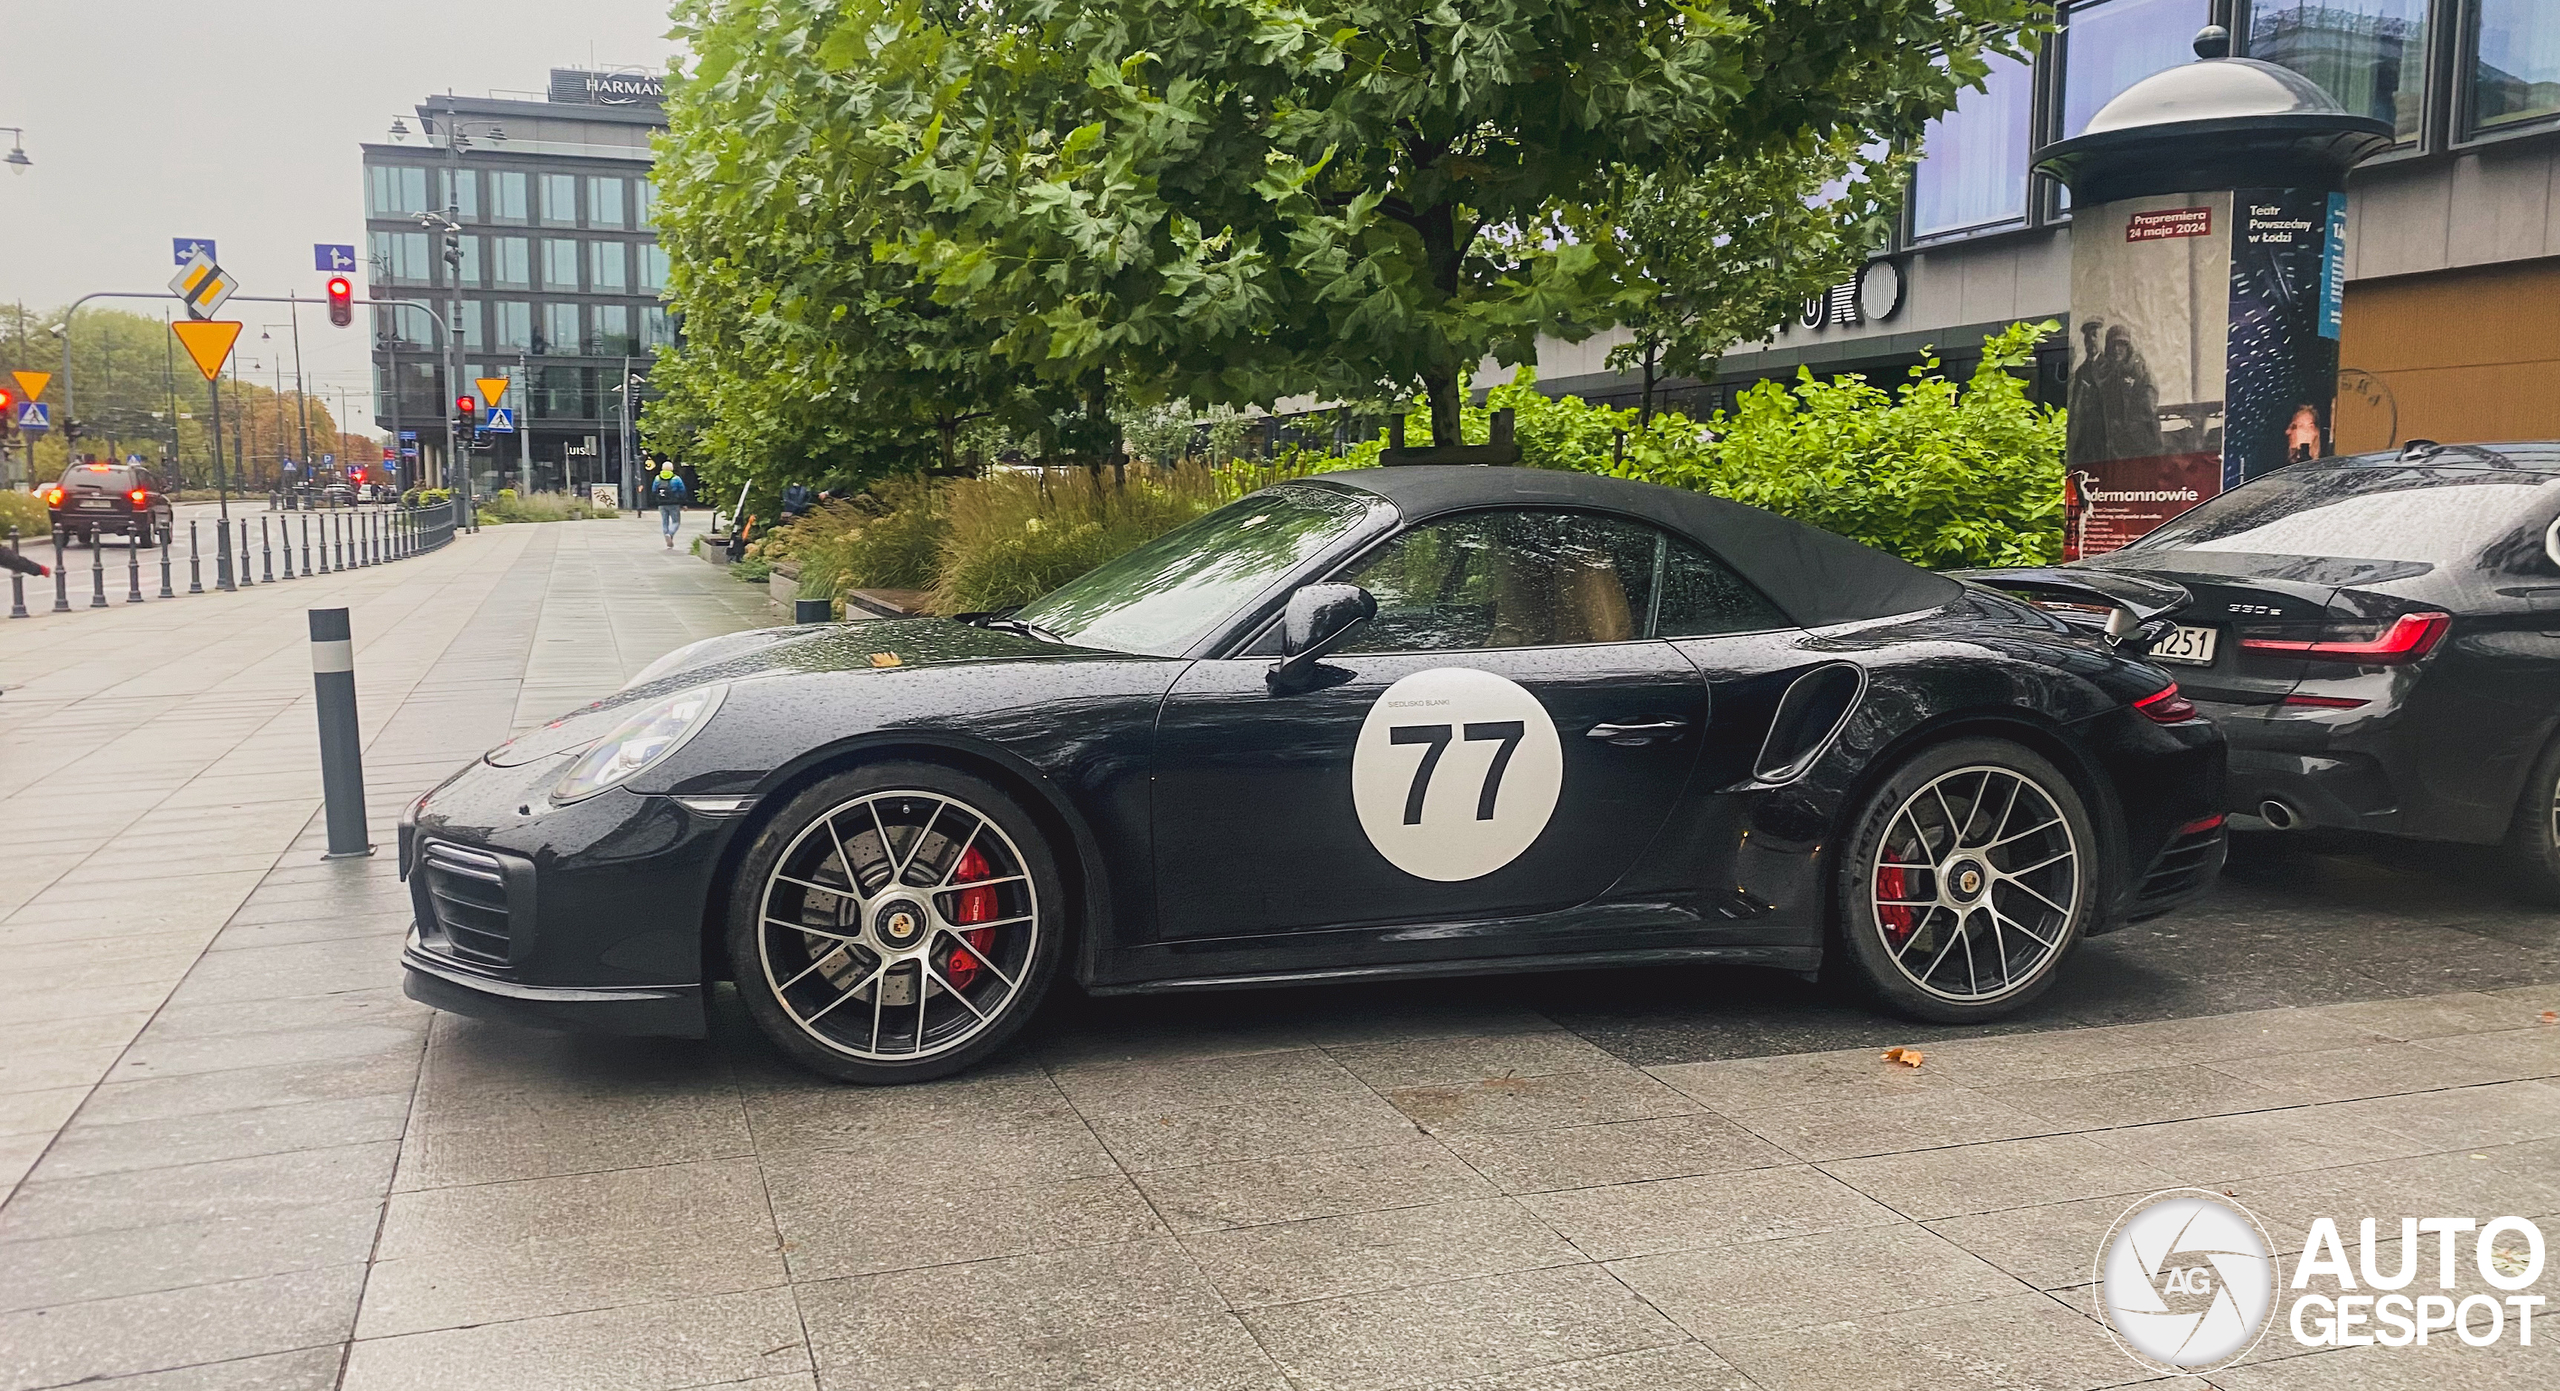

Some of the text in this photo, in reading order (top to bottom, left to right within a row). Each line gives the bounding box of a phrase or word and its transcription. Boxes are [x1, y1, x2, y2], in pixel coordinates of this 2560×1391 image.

[586, 78, 663, 96] HARMAN
[2134, 210, 2207, 226] Prapremiera
[2249, 205, 2281, 216] Teatr
[2129, 222, 2207, 239] 24 maja 2024
[2248, 232, 2293, 243] w Łodzi
[2089, 486, 2199, 502] dermannowie
[1390, 720, 1525, 826] 77
